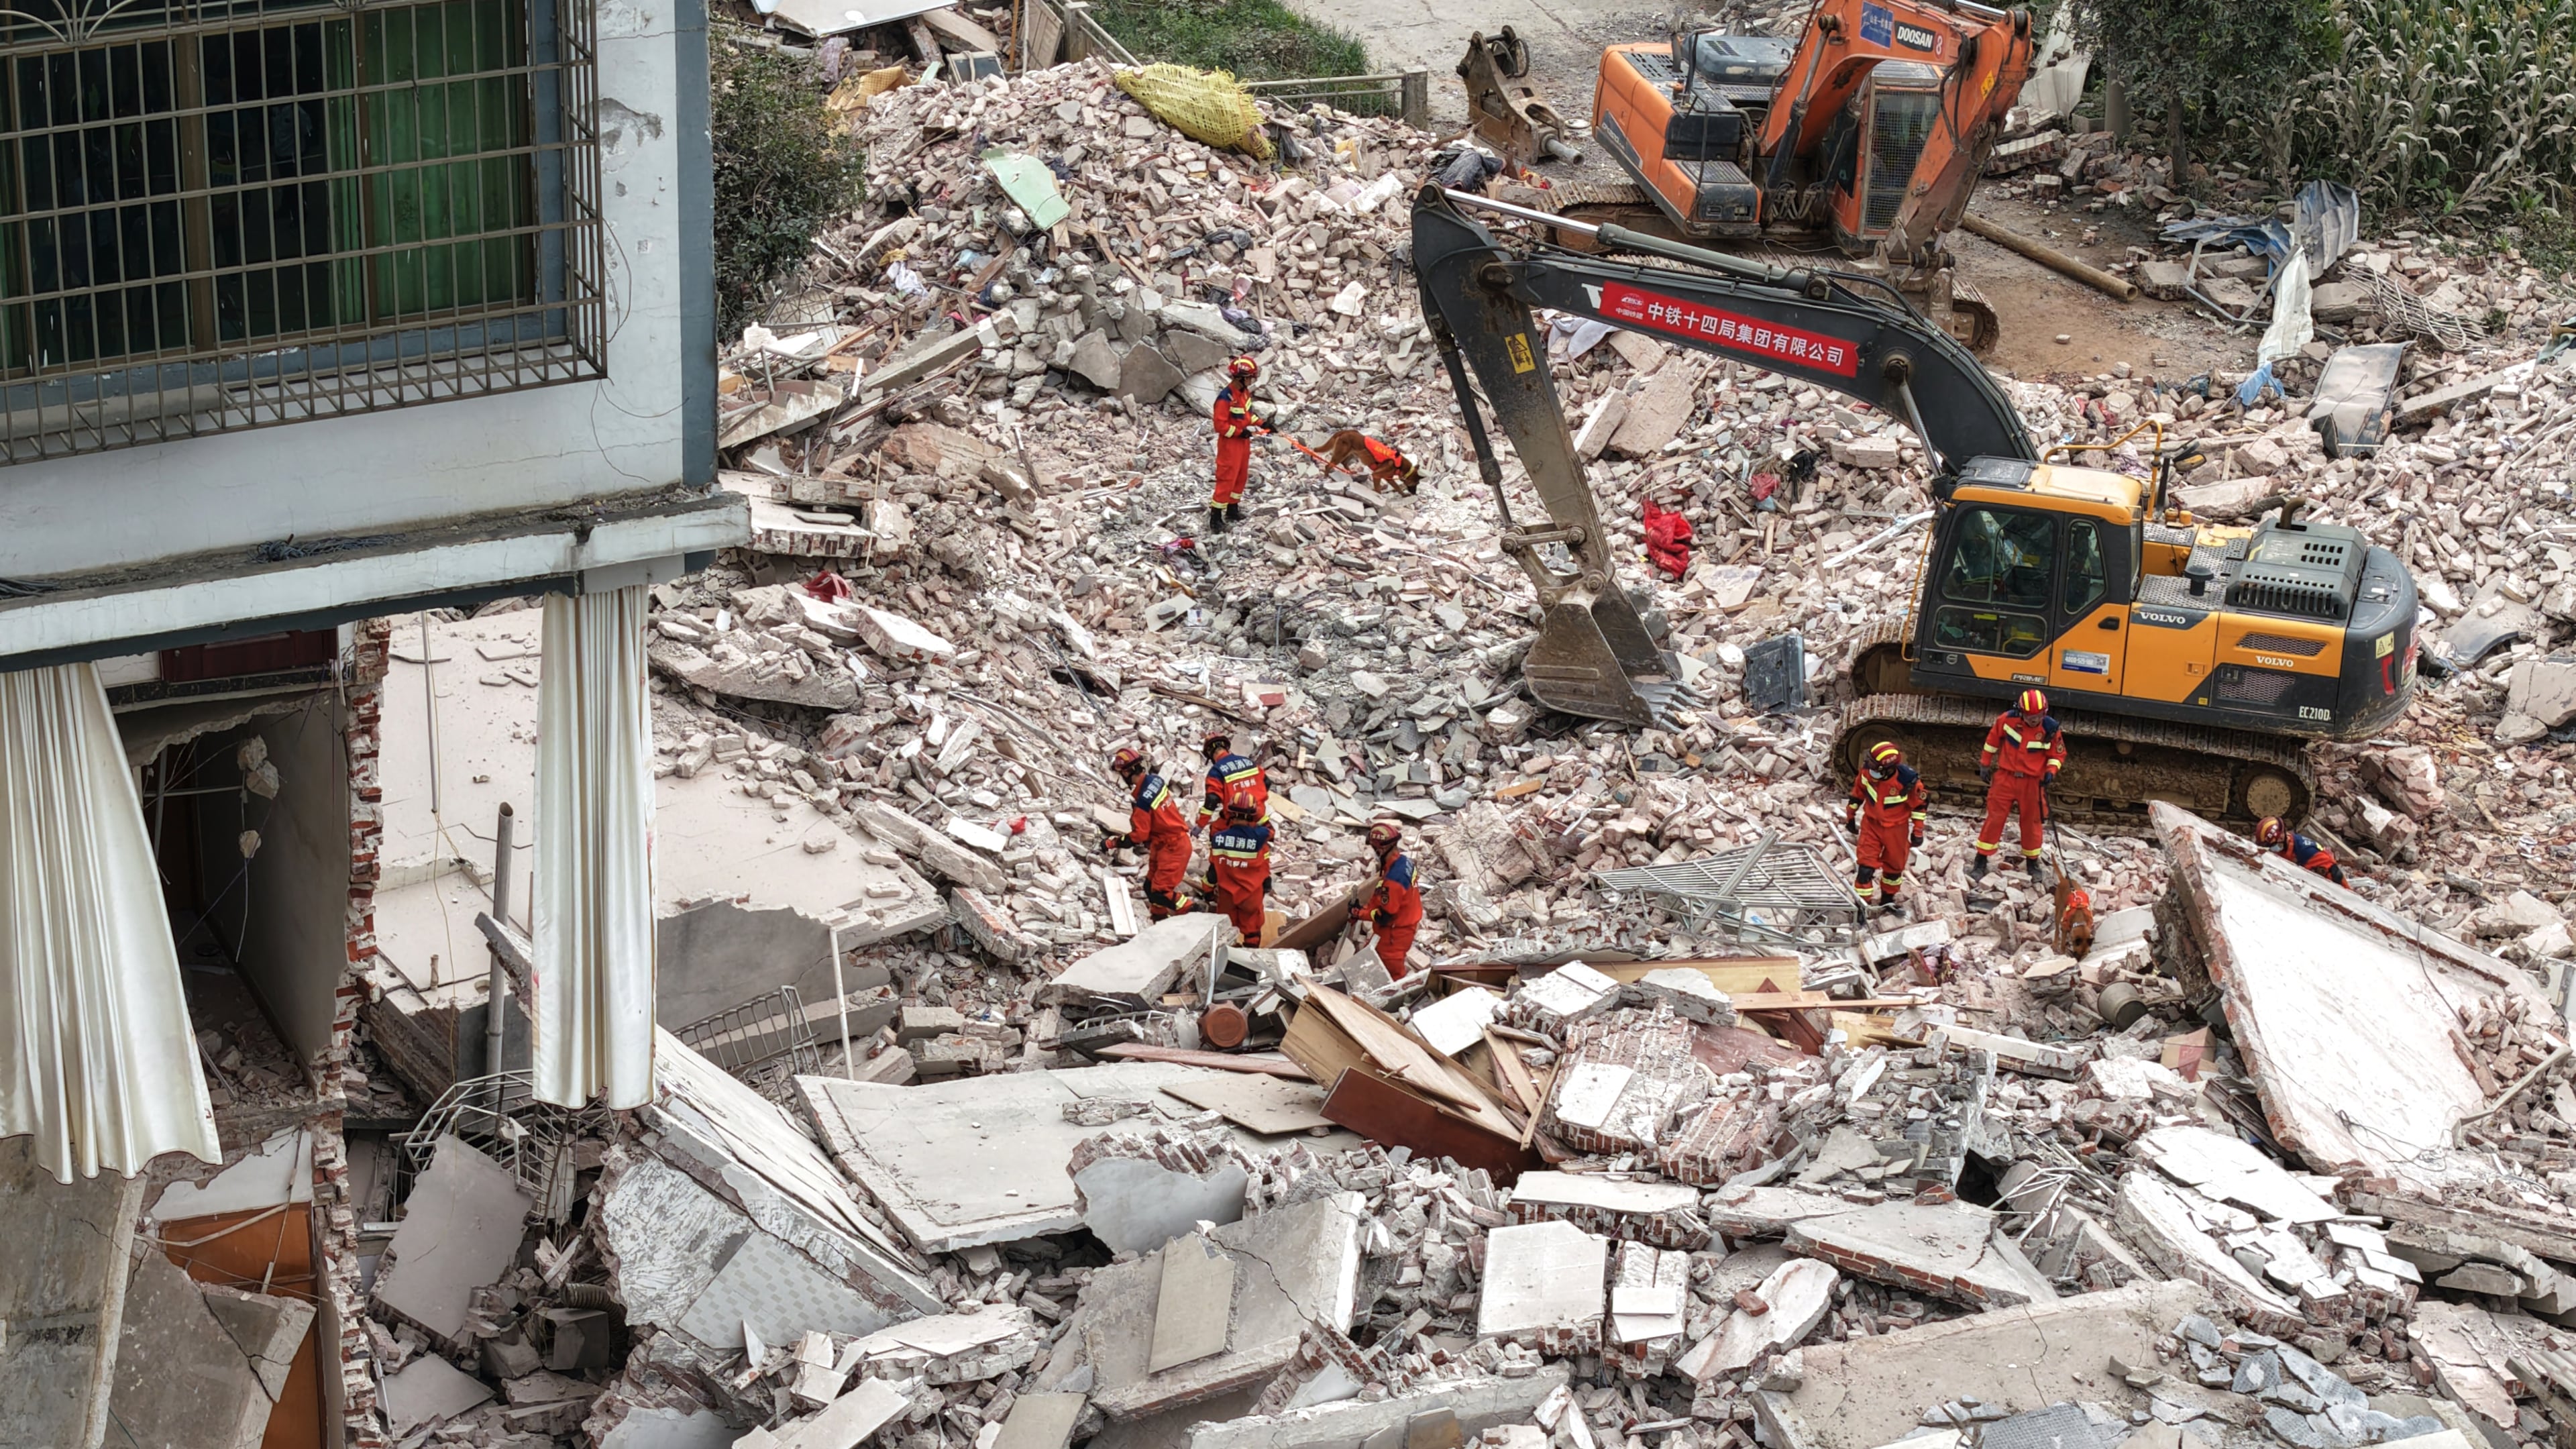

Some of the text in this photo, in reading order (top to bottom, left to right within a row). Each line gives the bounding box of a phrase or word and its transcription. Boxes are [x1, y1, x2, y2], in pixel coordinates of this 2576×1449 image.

[1897, 25, 1933, 48] DOOSAN
[1648, 301, 1843, 367] 中铁十四局集团有限公司
[2140, 611, 2186, 625] VOLVO
[2255, 655, 2294, 667] VOLVO
[2012, 674, 2045, 683] PRIME
[2298, 706, 2330, 721] EC210D
[1220, 758, 1253, 773] 中国消防
[1215, 834, 1257, 850] 中国消防
